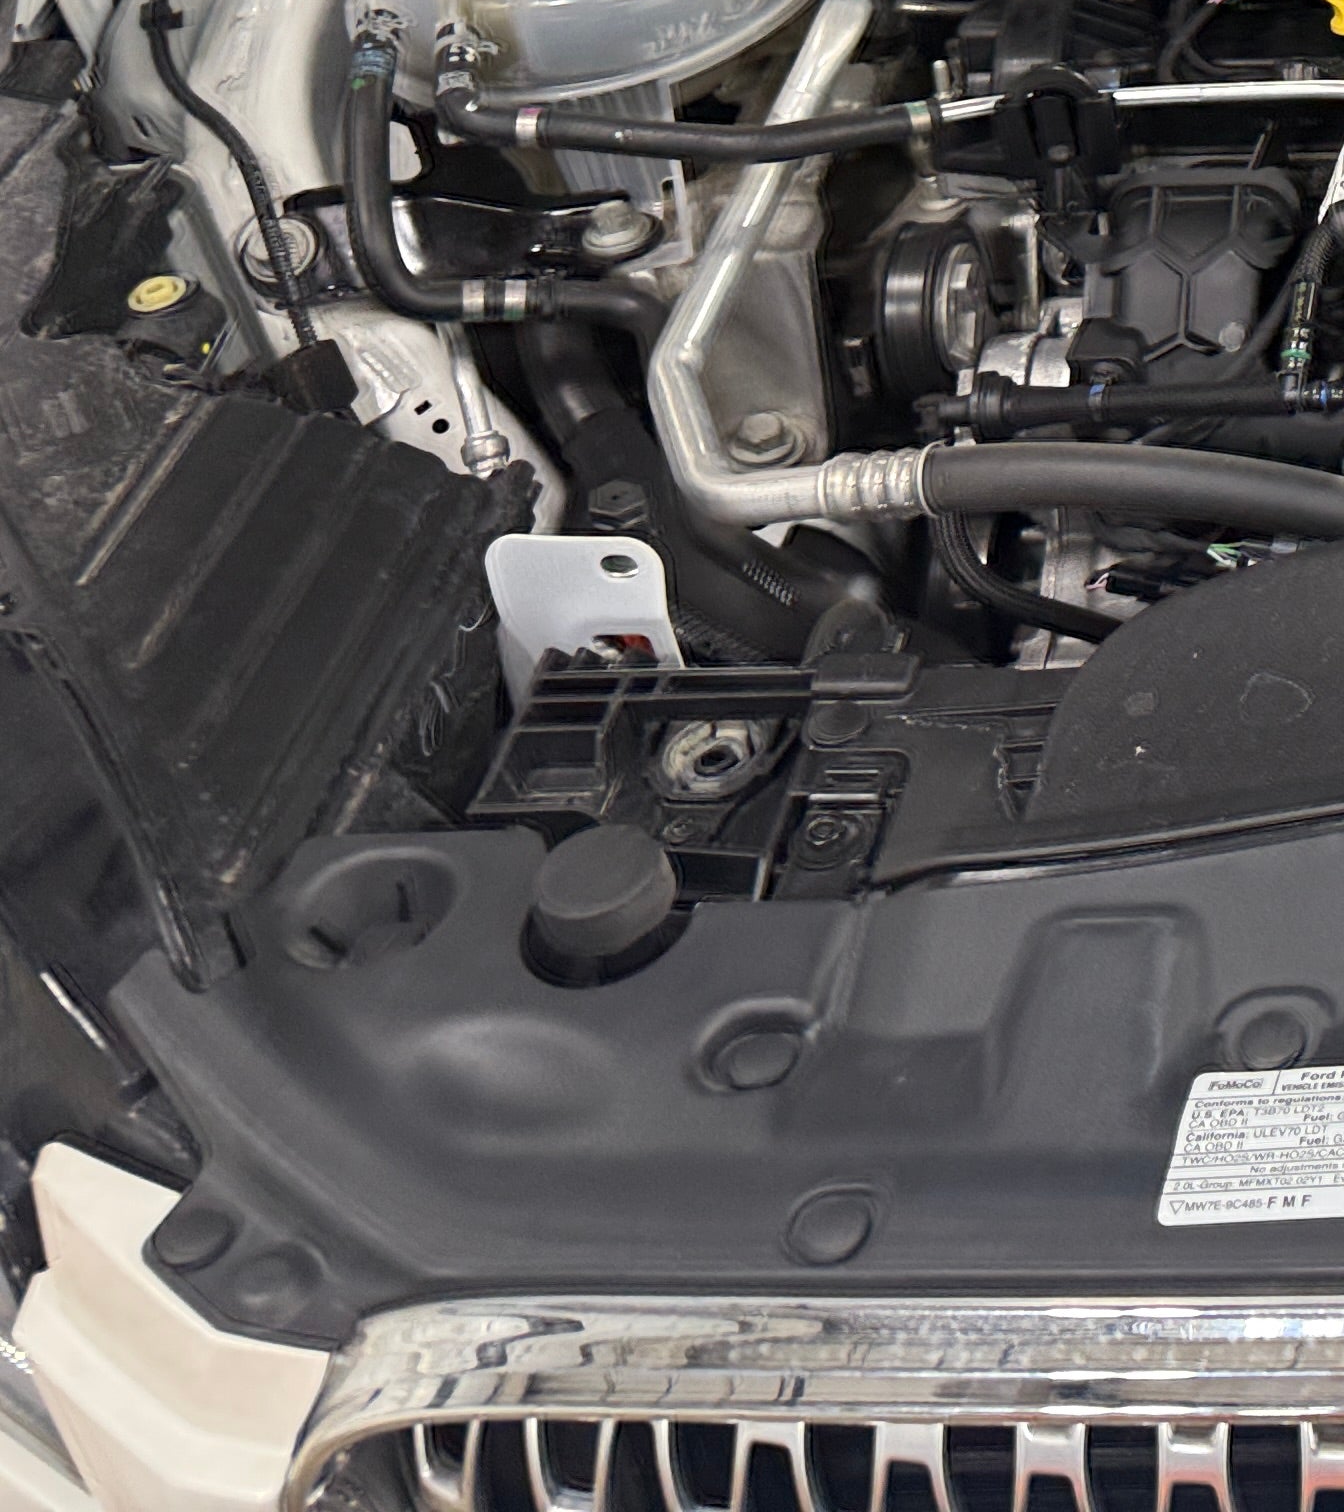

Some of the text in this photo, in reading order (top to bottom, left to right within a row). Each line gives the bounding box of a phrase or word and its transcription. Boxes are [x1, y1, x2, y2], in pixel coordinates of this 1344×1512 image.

[1300, 1071, 1336, 1081] Ford
[1281, 1083, 1318, 1092] VEHICLE
[1194, 1099, 1254, 1109] Conforms
[1257, 1097, 1270, 1105] to
[1273, 1094, 1344, 1106] regulations:
[1188, 1120, 1206, 1130] CA
[1209, 1118, 1237, 1128] OBD
[1303, 1113, 1332, 1122] Fuel:
[1185, 1125, 1328, 1142] California: ULEV70 LDT
[1183, 1143, 1201, 1153] CA
[1204, 1141, 1232, 1152] OBD
[1299, 1135, 1329, 1146] Fuel:
[1250, 1164, 1266, 1174] No
[1269, 1161, 1339, 1175] adjustments
